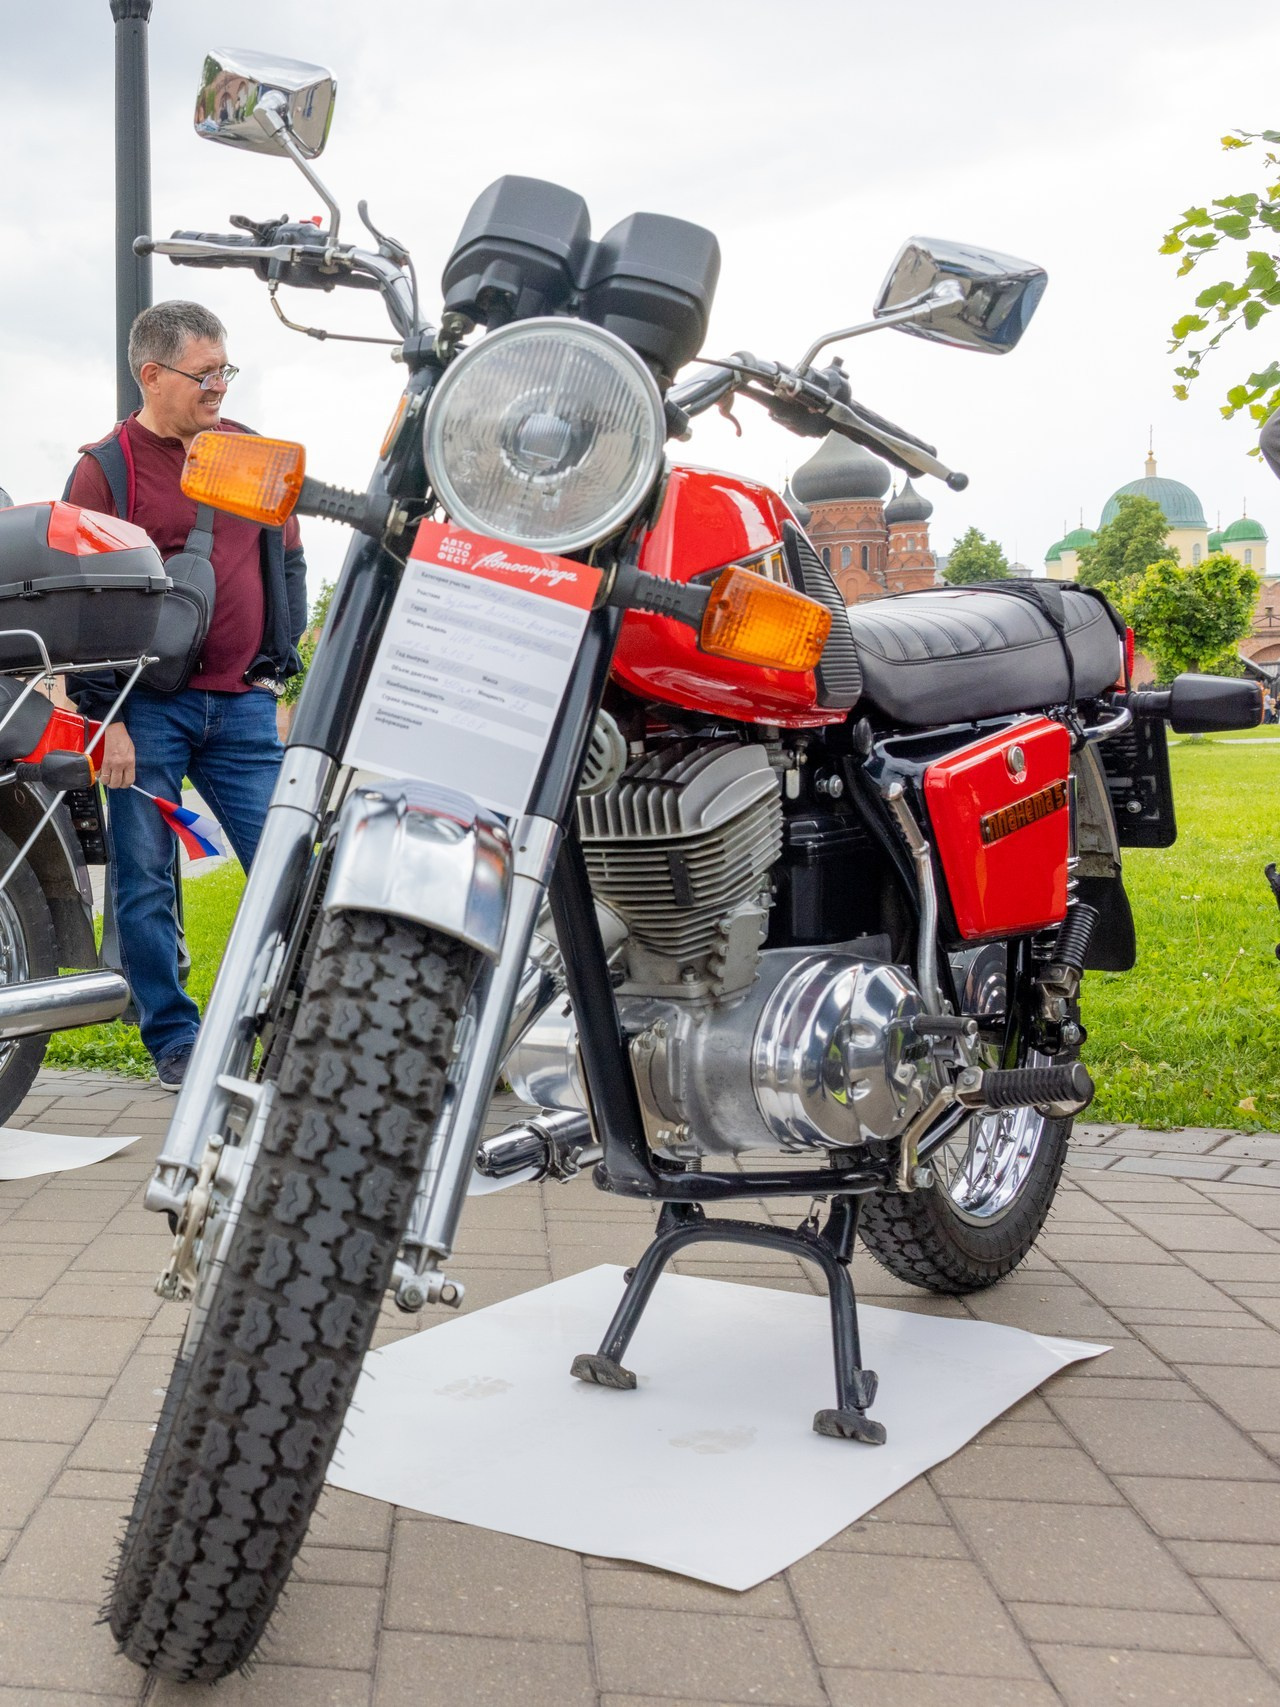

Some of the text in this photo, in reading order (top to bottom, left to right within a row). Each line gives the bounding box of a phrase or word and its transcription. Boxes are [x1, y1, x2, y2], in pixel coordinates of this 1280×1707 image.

[439, 543, 469, 558] МОТО
[441, 536, 472, 551] АВТО
[436, 551, 467, 566] ФЕСТ
[471, 551, 578, 586] Автострада
